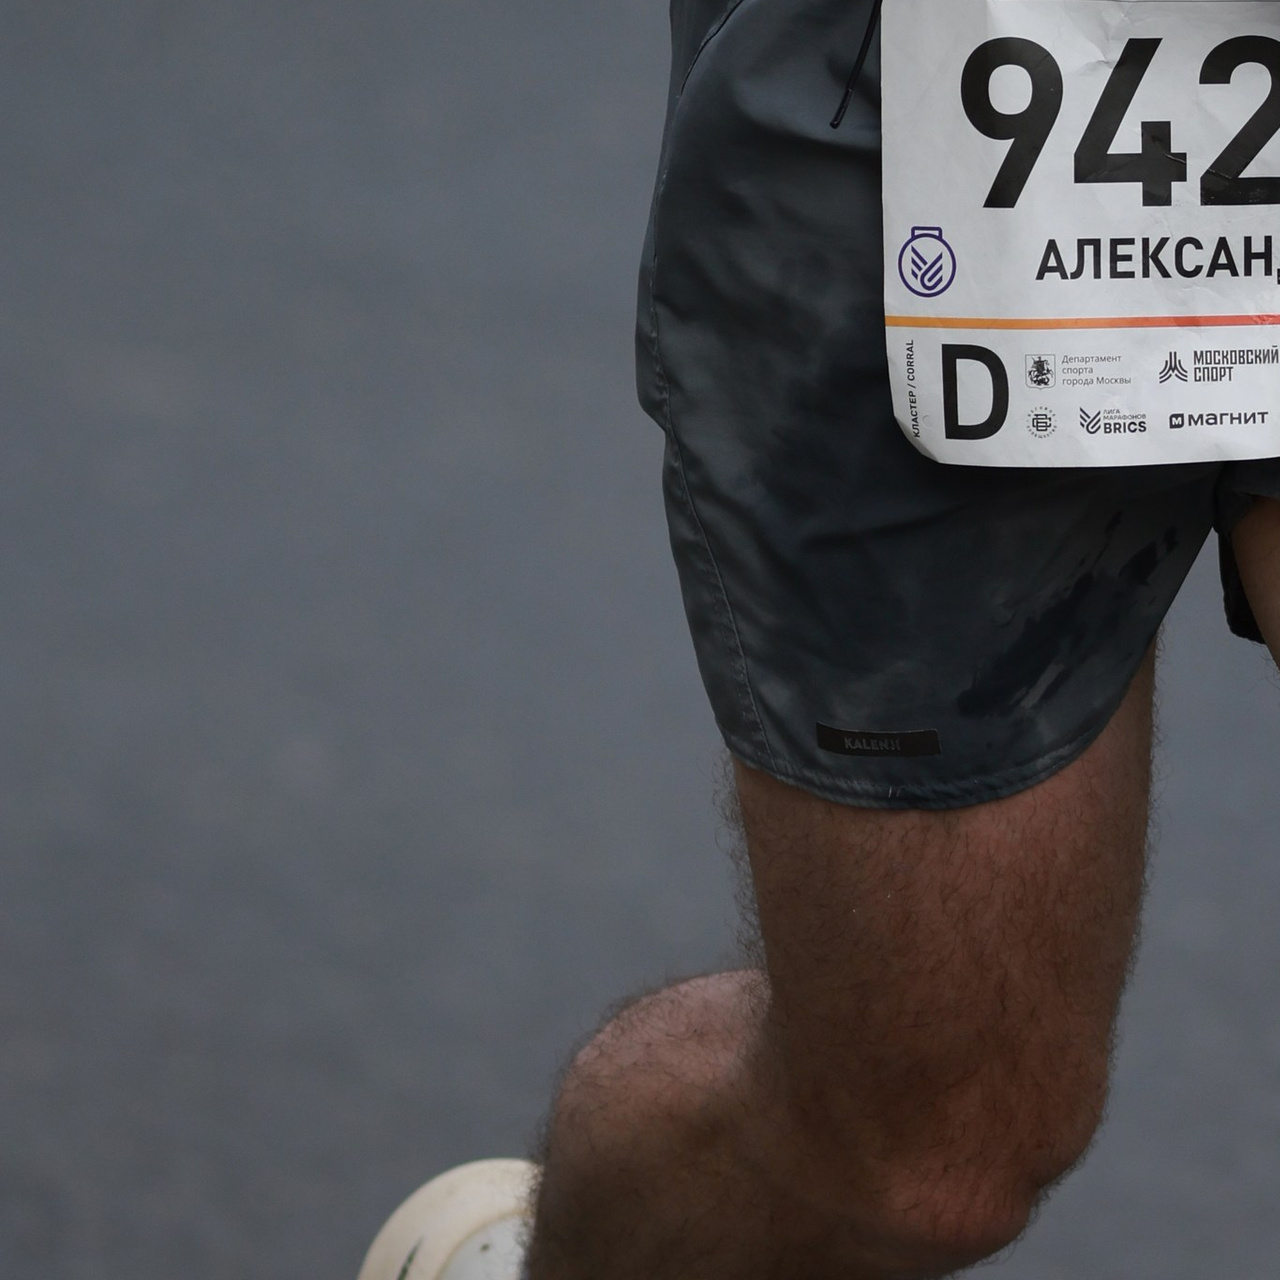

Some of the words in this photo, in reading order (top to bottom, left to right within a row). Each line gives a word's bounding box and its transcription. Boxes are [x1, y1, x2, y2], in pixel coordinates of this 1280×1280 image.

[905, 339, 916, 382] CORRAL
[1061, 354, 1122, 365] Департамент
[1193, 344, 1279, 366] МОСКОВСКИЙ
[1061, 367, 1094, 376] спорта
[1193, 366, 1234, 383] СПОРТ
[1062, 378, 1094, 387] города
[1096, 376, 1132, 385] Москвы
[941, 343, 1010, 441] D
[908, 390, 921, 438] КЛАСТЕР
[1103, 420, 1147, 435] BRICS
